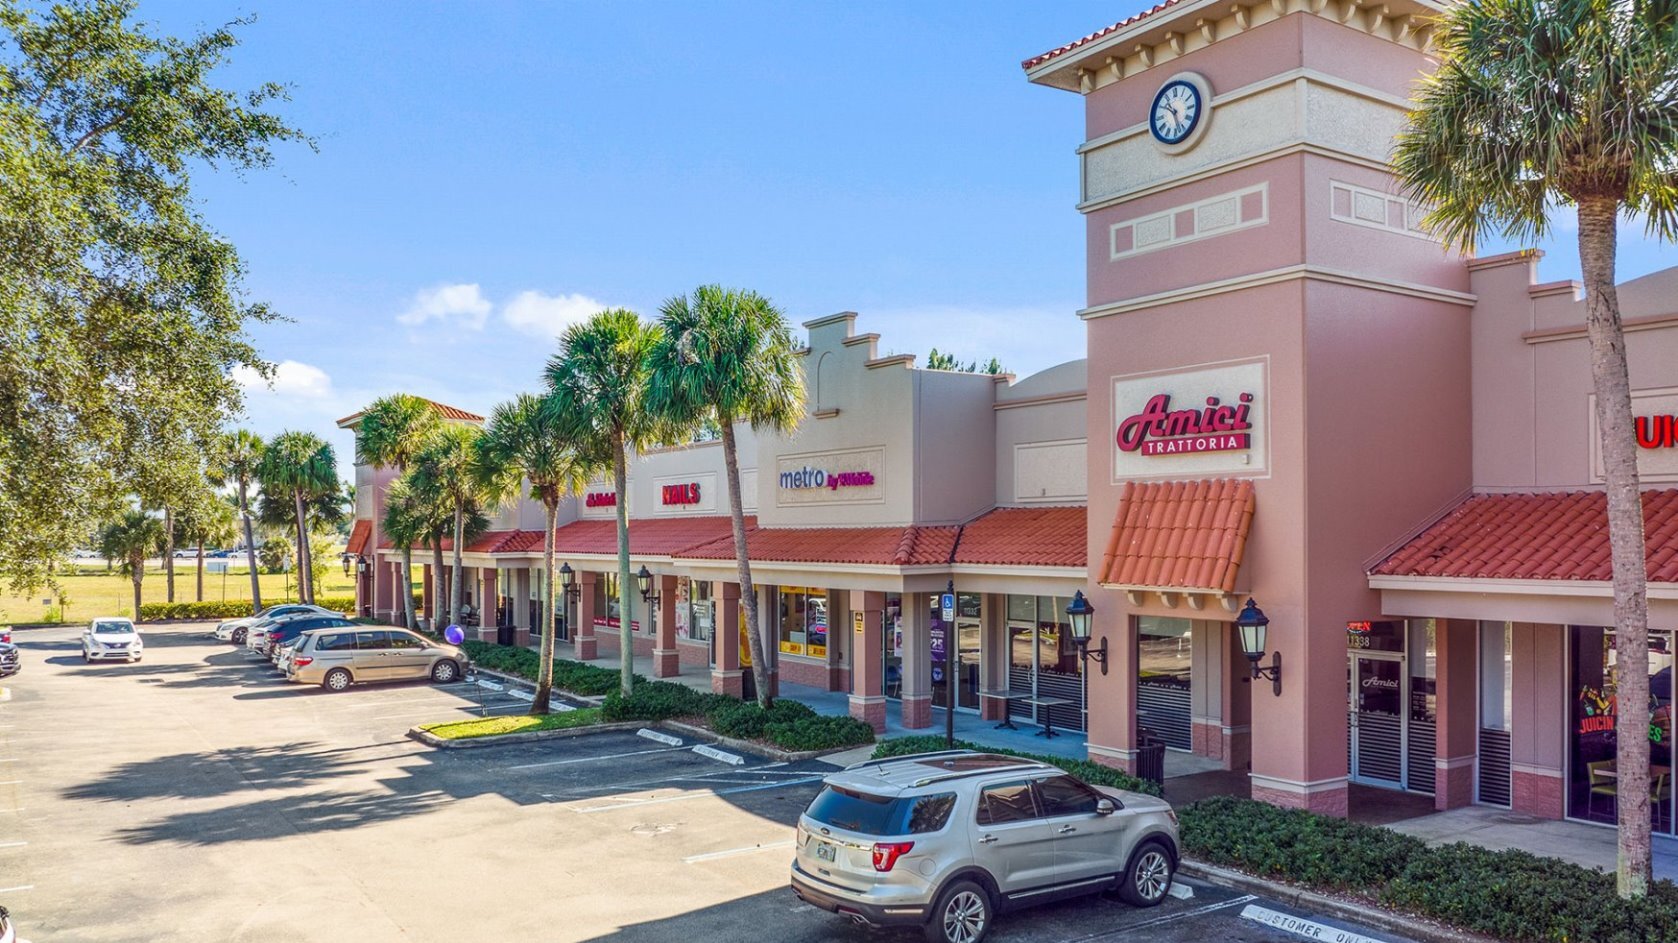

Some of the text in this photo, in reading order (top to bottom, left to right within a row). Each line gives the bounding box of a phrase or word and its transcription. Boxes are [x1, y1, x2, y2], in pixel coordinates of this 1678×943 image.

[1117, 393, 1253, 452] Amici
[1148, 436, 1238, 454] TRATTORIA
[780, 466, 824, 489] metro
[662, 482, 701, 505] NAILS
[1347, 621, 1371, 632] PEN
[1362, 676, 1399, 688] Amici
[1648, 723, 1663, 742] ES
[1256, 910, 1322, 938] CUSTOMER
